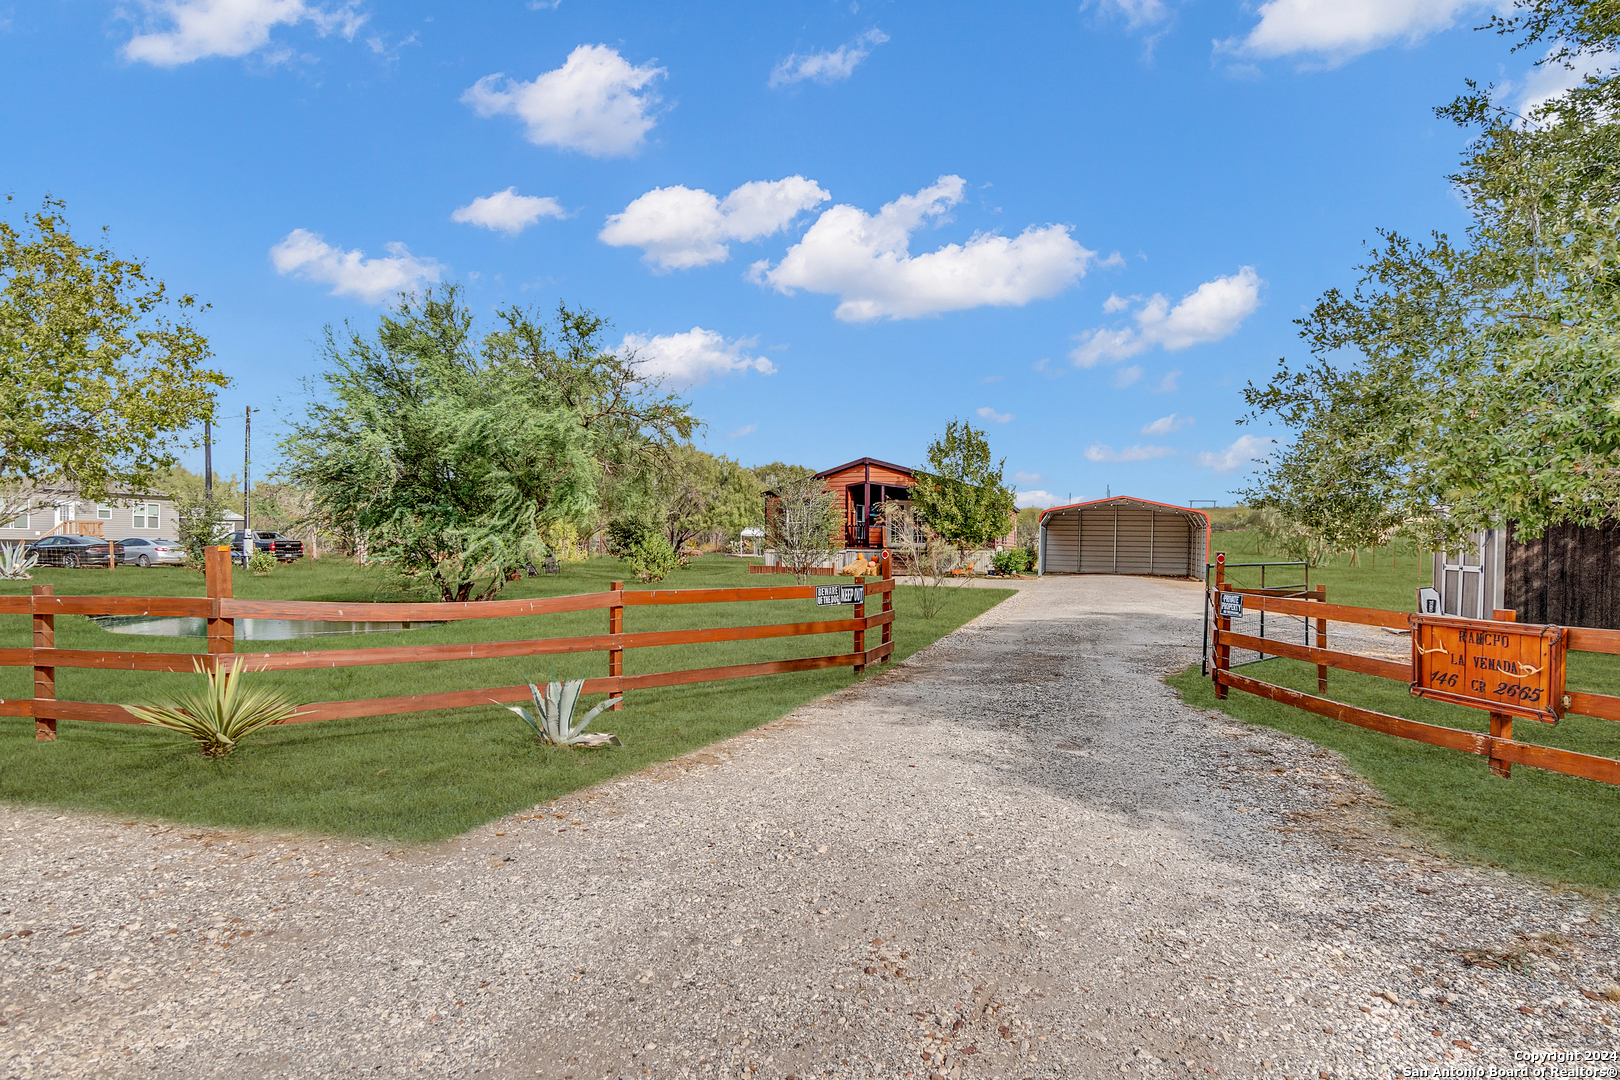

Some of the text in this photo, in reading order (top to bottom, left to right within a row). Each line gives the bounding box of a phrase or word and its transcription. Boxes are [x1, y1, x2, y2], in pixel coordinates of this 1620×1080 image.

[818, 587, 838, 596] BEWARE
[841, 588, 863, 601] KEEP OUT
[818, 596, 823, 604] OF
[823, 596, 831, 604] THE
[1223, 595, 1240, 603] PRIVATE
[1222, 603, 1241, 611] PROPERTY
[1459, 630, 1509, 648] RANCHO
[1450, 653, 1518, 674] LA VENADA
[1431, 670, 1544, 701] 146 CR 2665
